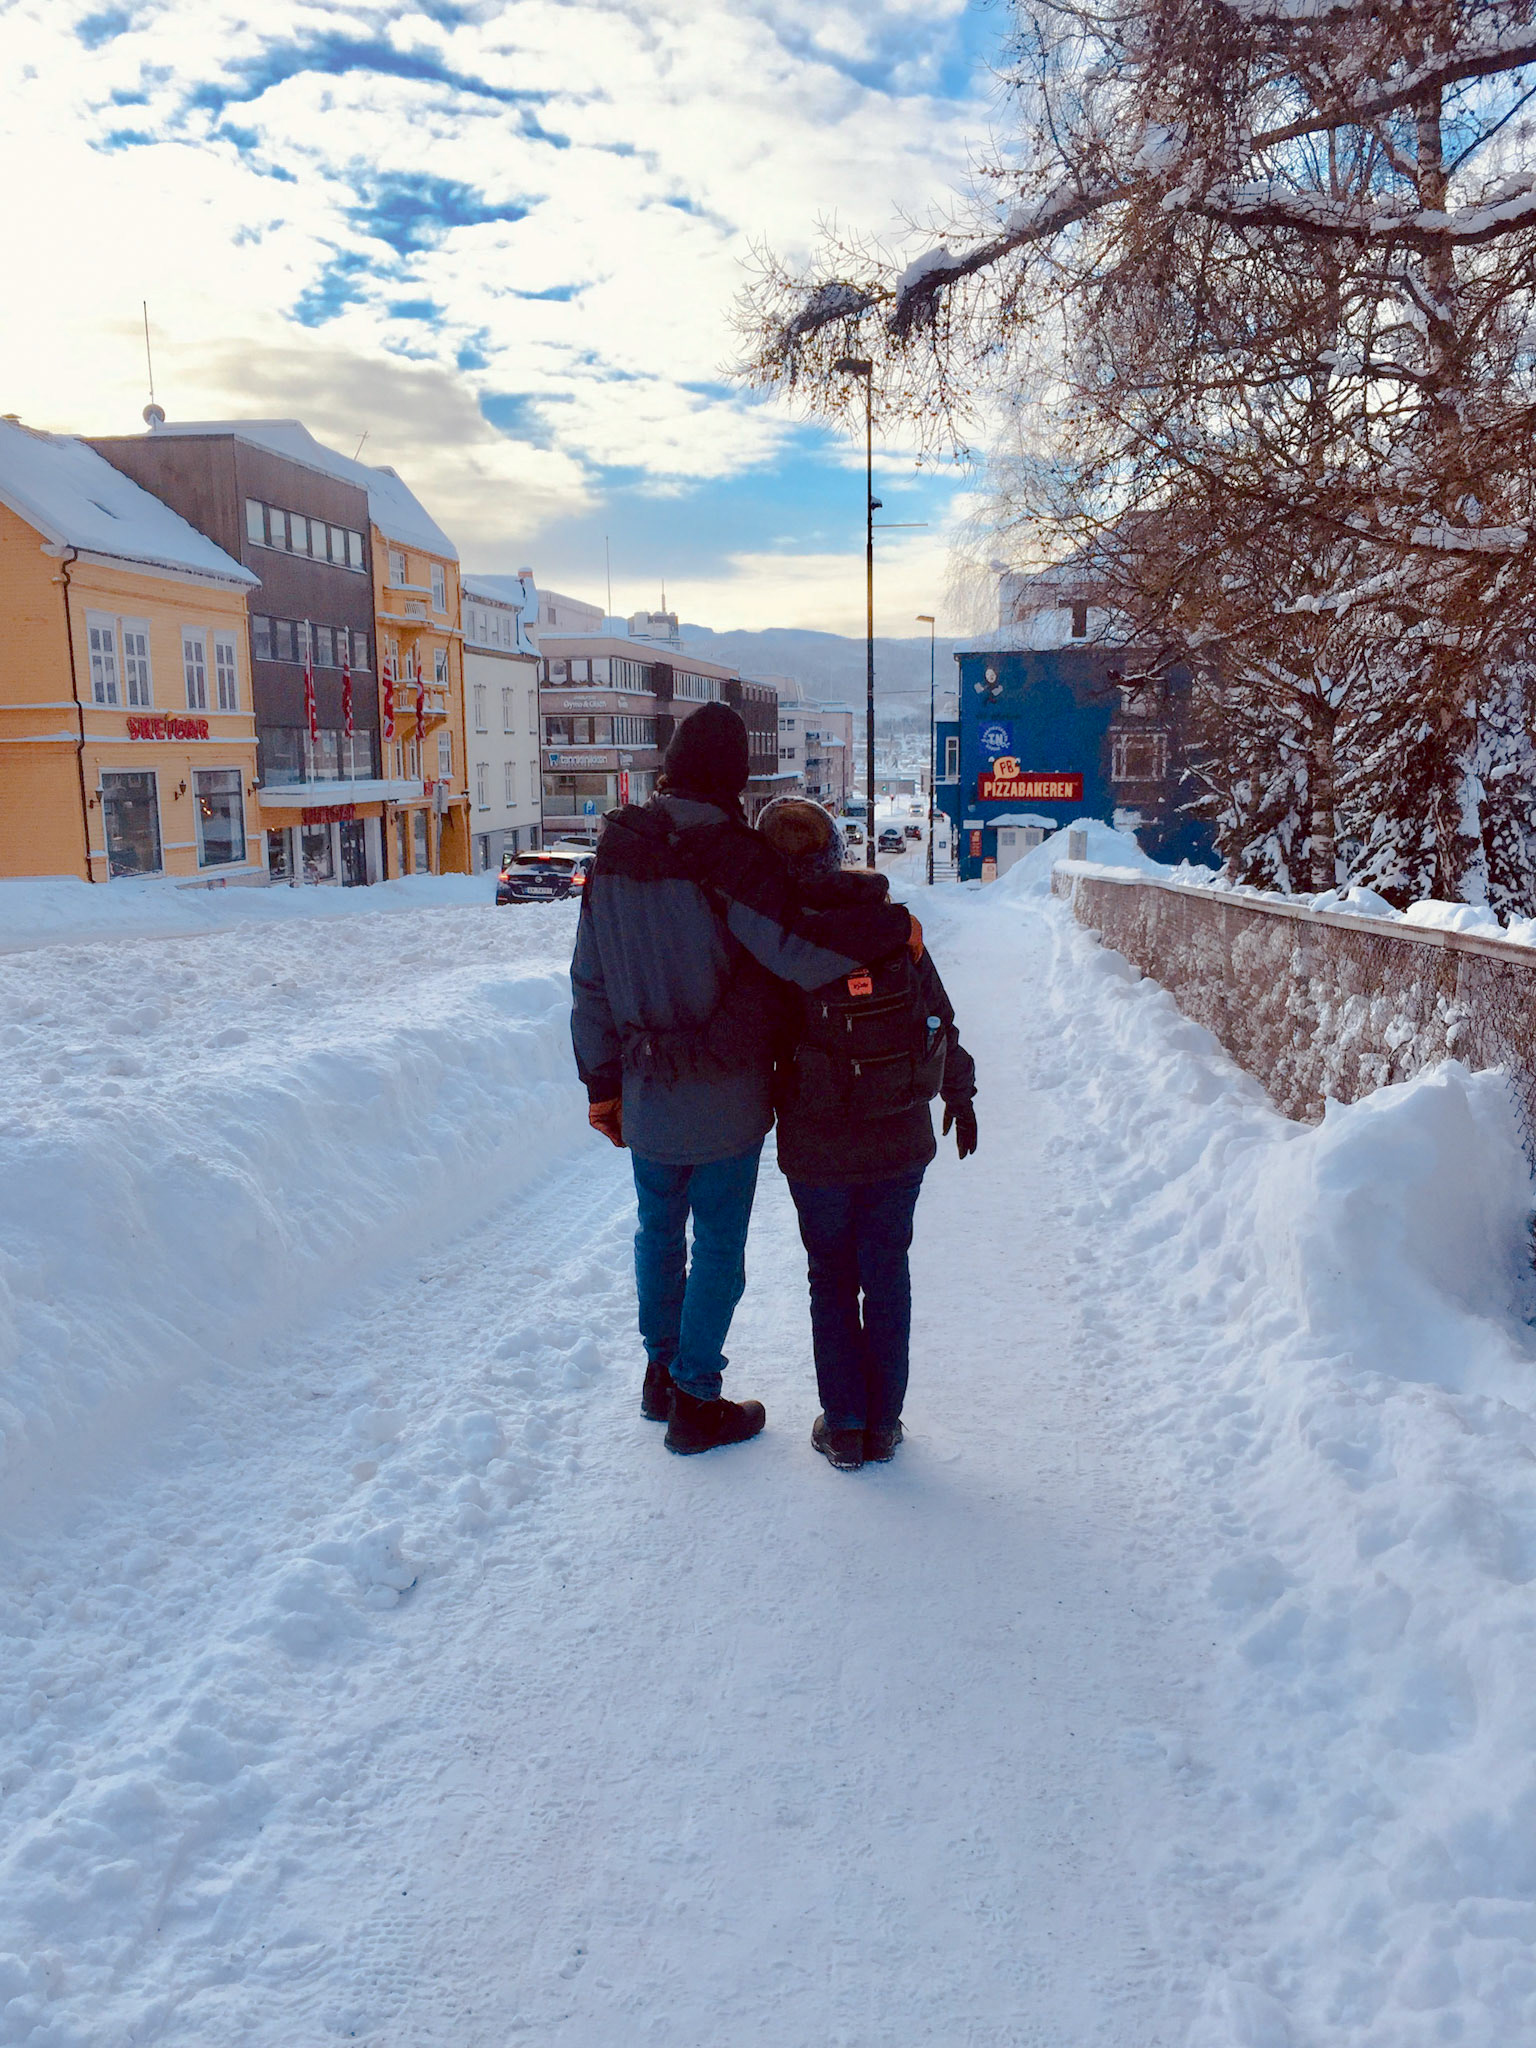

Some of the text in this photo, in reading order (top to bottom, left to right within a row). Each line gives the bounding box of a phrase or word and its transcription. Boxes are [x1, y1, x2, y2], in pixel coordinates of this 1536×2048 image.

[999, 760, 1014, 775] PB
[983, 781, 1073, 798] PIZZABAKEREN
[586, 800, 593, 814] P
